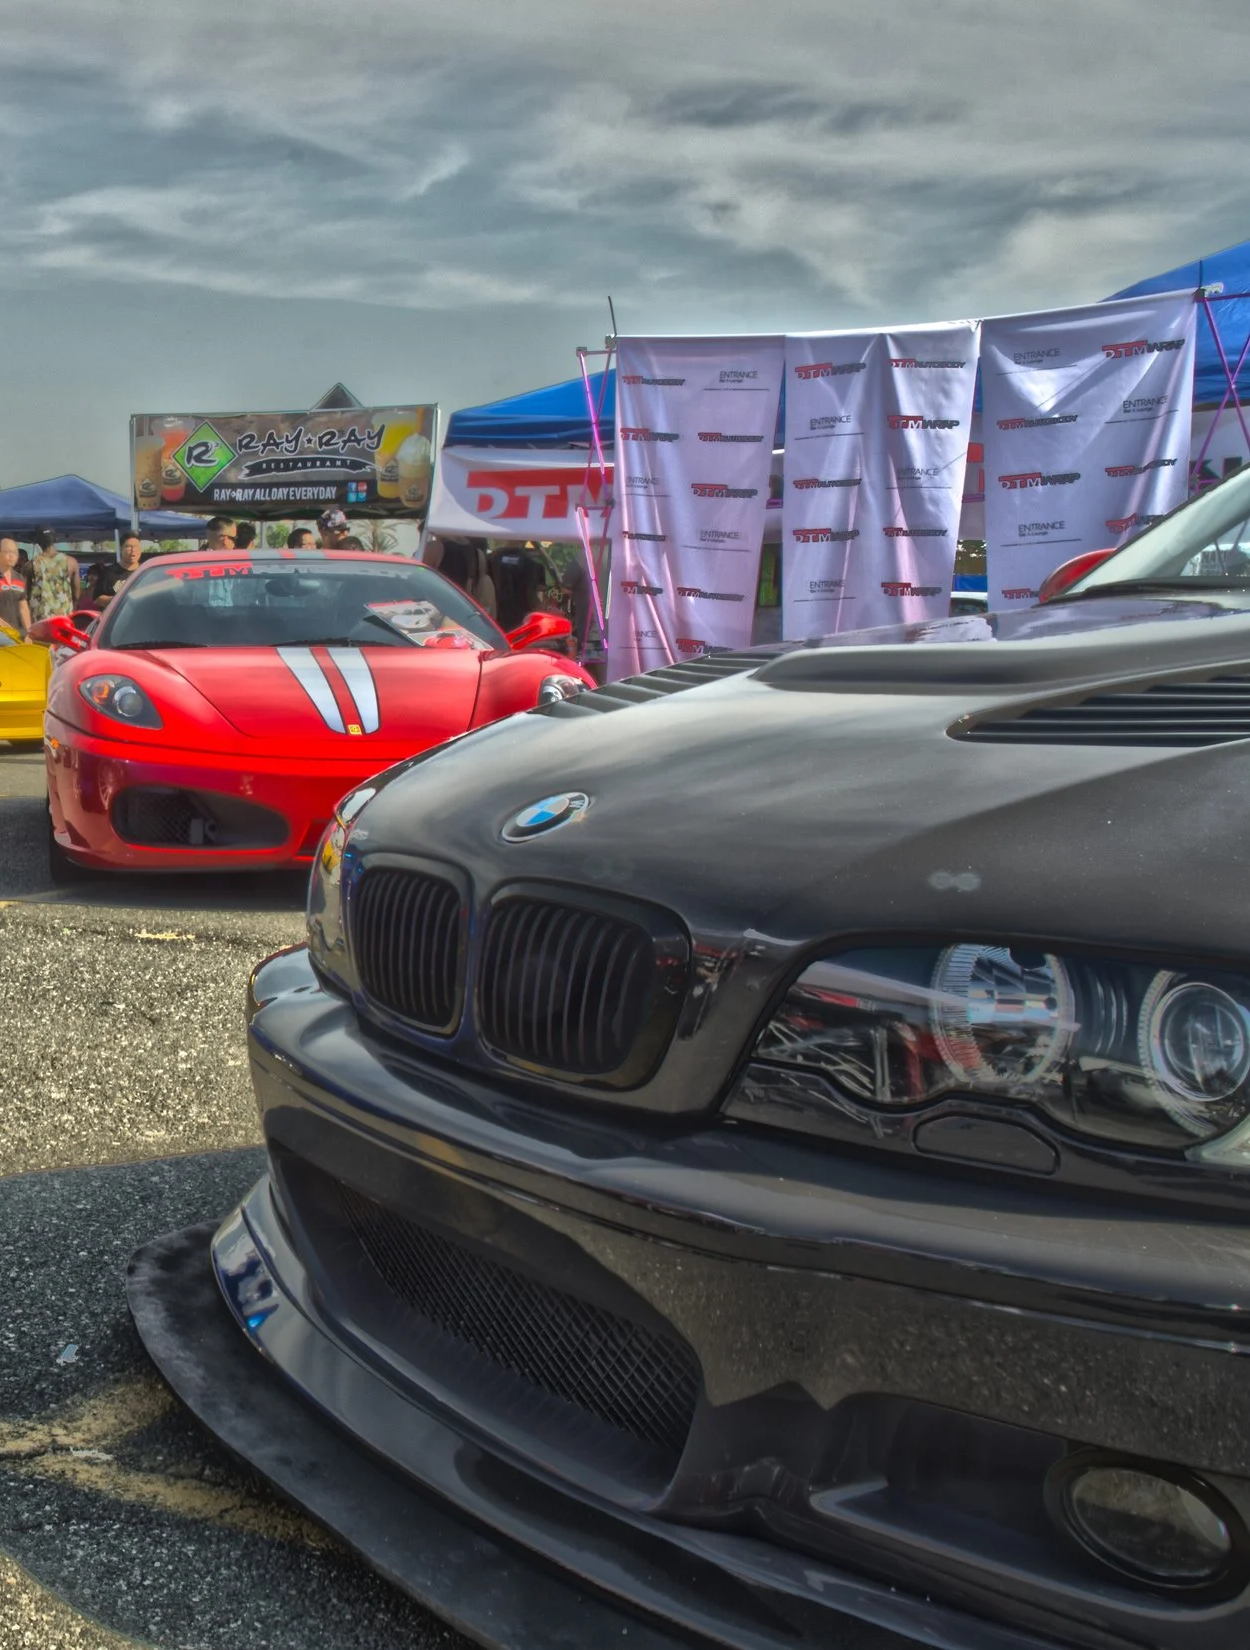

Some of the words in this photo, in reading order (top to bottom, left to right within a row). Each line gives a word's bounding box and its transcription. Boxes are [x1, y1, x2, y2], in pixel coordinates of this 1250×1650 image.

[1014, 348, 1060, 361] ENTRANCE
[1102, 340, 1186, 360] DTMWRAP
[719, 370, 758, 379] ENTRANCE
[810, 415, 852, 426] ENTRANCE
[237, 426, 304, 454] RAY
[316, 423, 386, 452] RAY
[261, 460, 351, 470] RESTAURANT
[998, 472, 1081, 489] DTMWRAP
[214, 487, 232, 501] RAY
[235, 487, 254, 501] RAY
[254, 487, 271, 500] ALL
[271, 487, 289, 500] DAY
[290, 486, 337, 500] EVERYDAY
[1018, 520, 1065, 532] ENTRANCE
[700, 530, 739, 539] ENTRANCE
